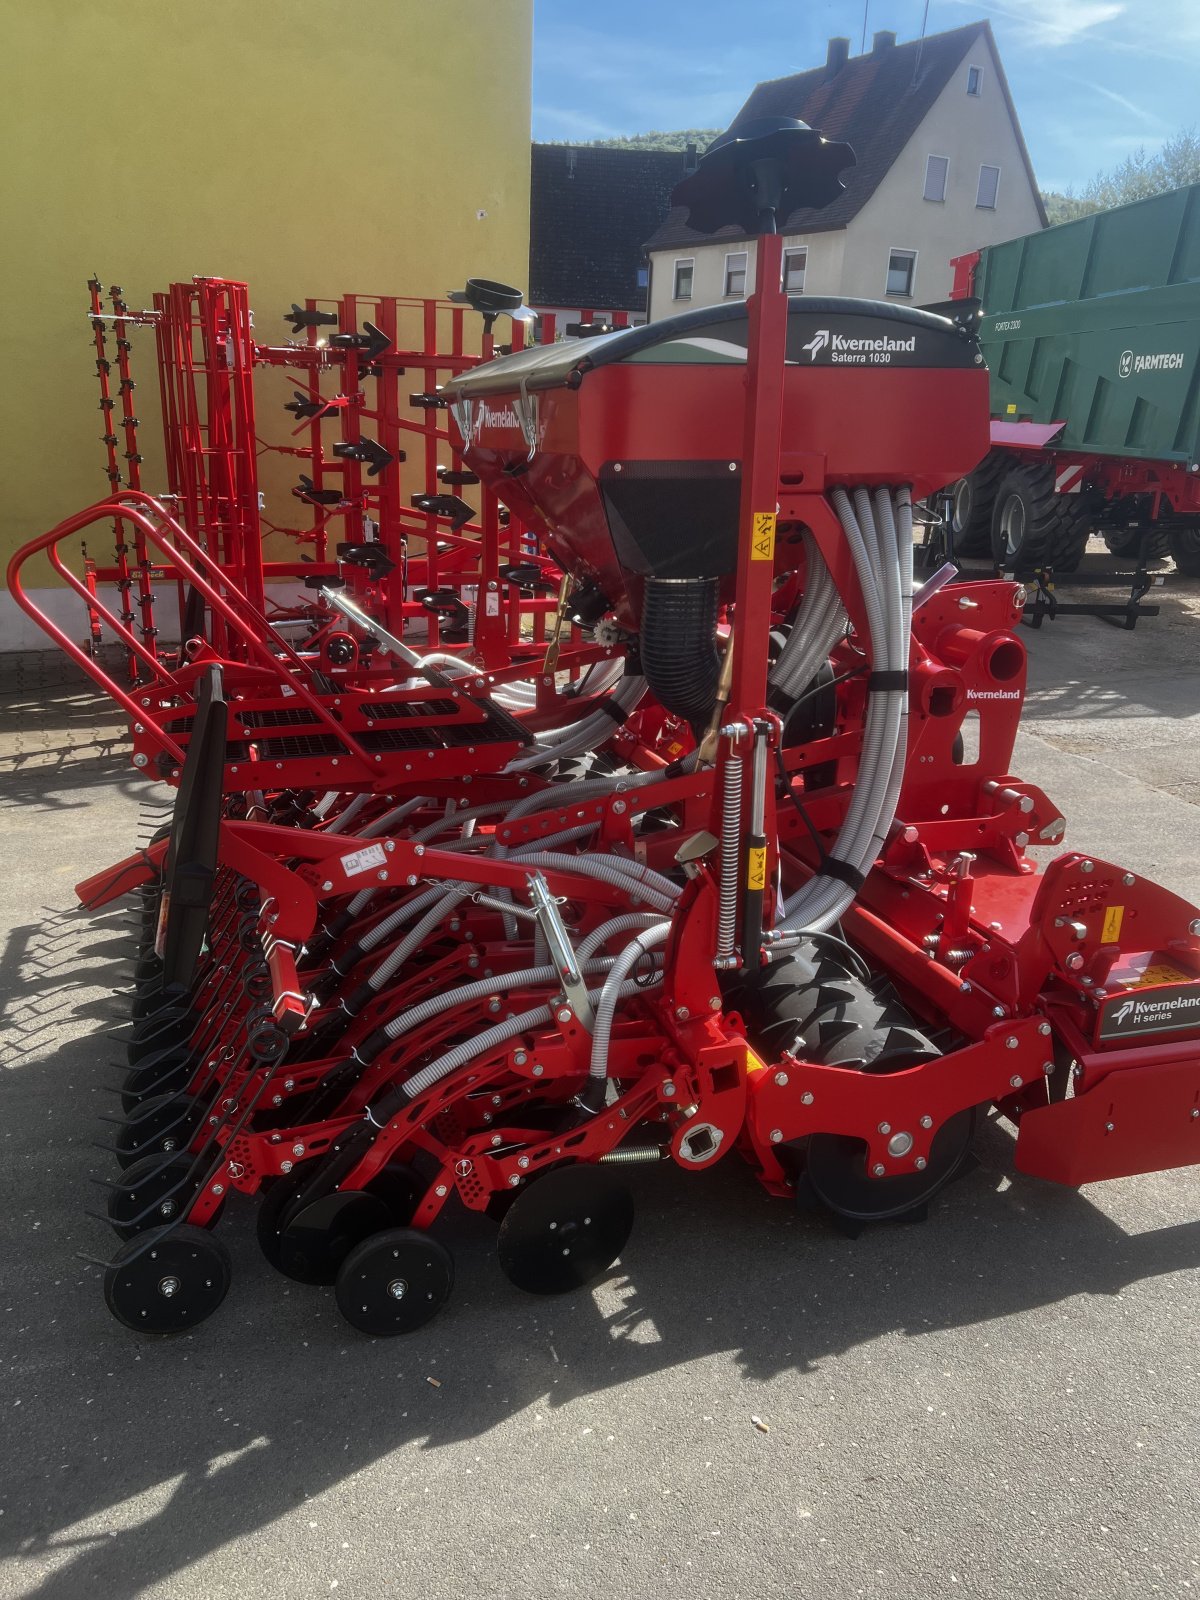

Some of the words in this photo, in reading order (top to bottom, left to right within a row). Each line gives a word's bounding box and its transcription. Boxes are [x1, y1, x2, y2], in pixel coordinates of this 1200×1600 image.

[831, 334, 916, 352] Kverneland
[831, 352, 866, 363] Saterra
[869, 352, 891, 363] 1030
[1134, 353, 1185, 373] FARMTECH
[966, 689, 1020, 699] Kverneland
[1133, 1014, 1141, 1024] H
[1143, 1011, 1172, 1022] series
